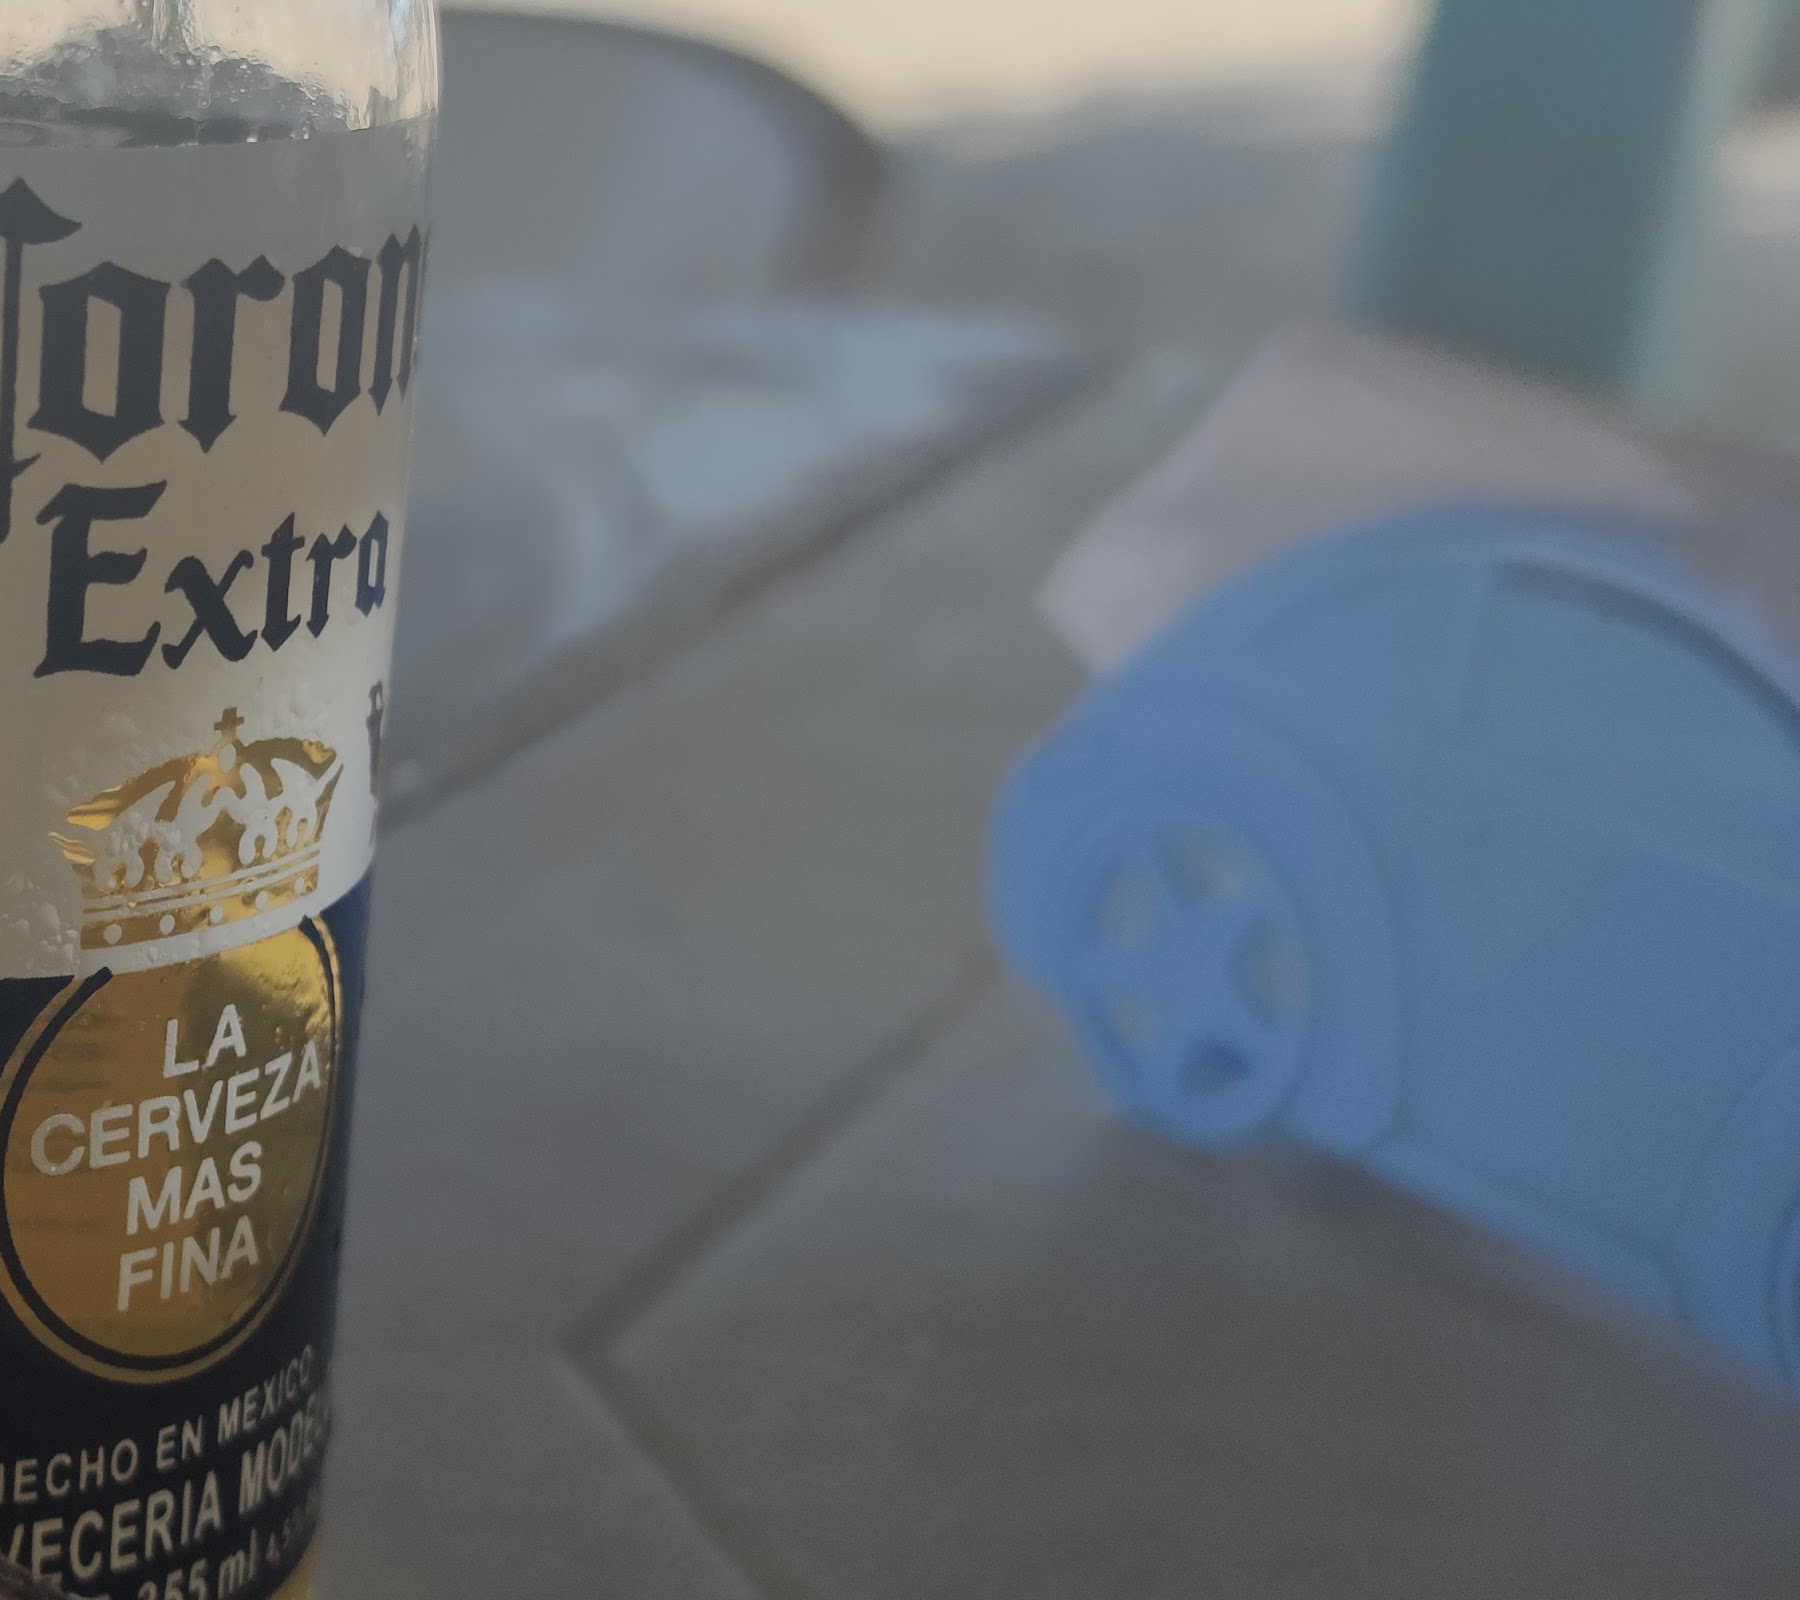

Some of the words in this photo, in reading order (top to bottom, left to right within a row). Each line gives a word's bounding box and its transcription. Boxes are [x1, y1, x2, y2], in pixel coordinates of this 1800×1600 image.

[32, 479, 390, 679] Extra
[162, 1003, 247, 1079] LA
[30, 1039, 322, 1176] CERVEZA
[126, 1140, 263, 1236] MAS
[116, 1215, 259, 1313] FINA
[156, 1415, 203, 1470] EN
[217, 1343, 314, 1445] MEXICO
[237, 1392, 323, 1517] MODE
